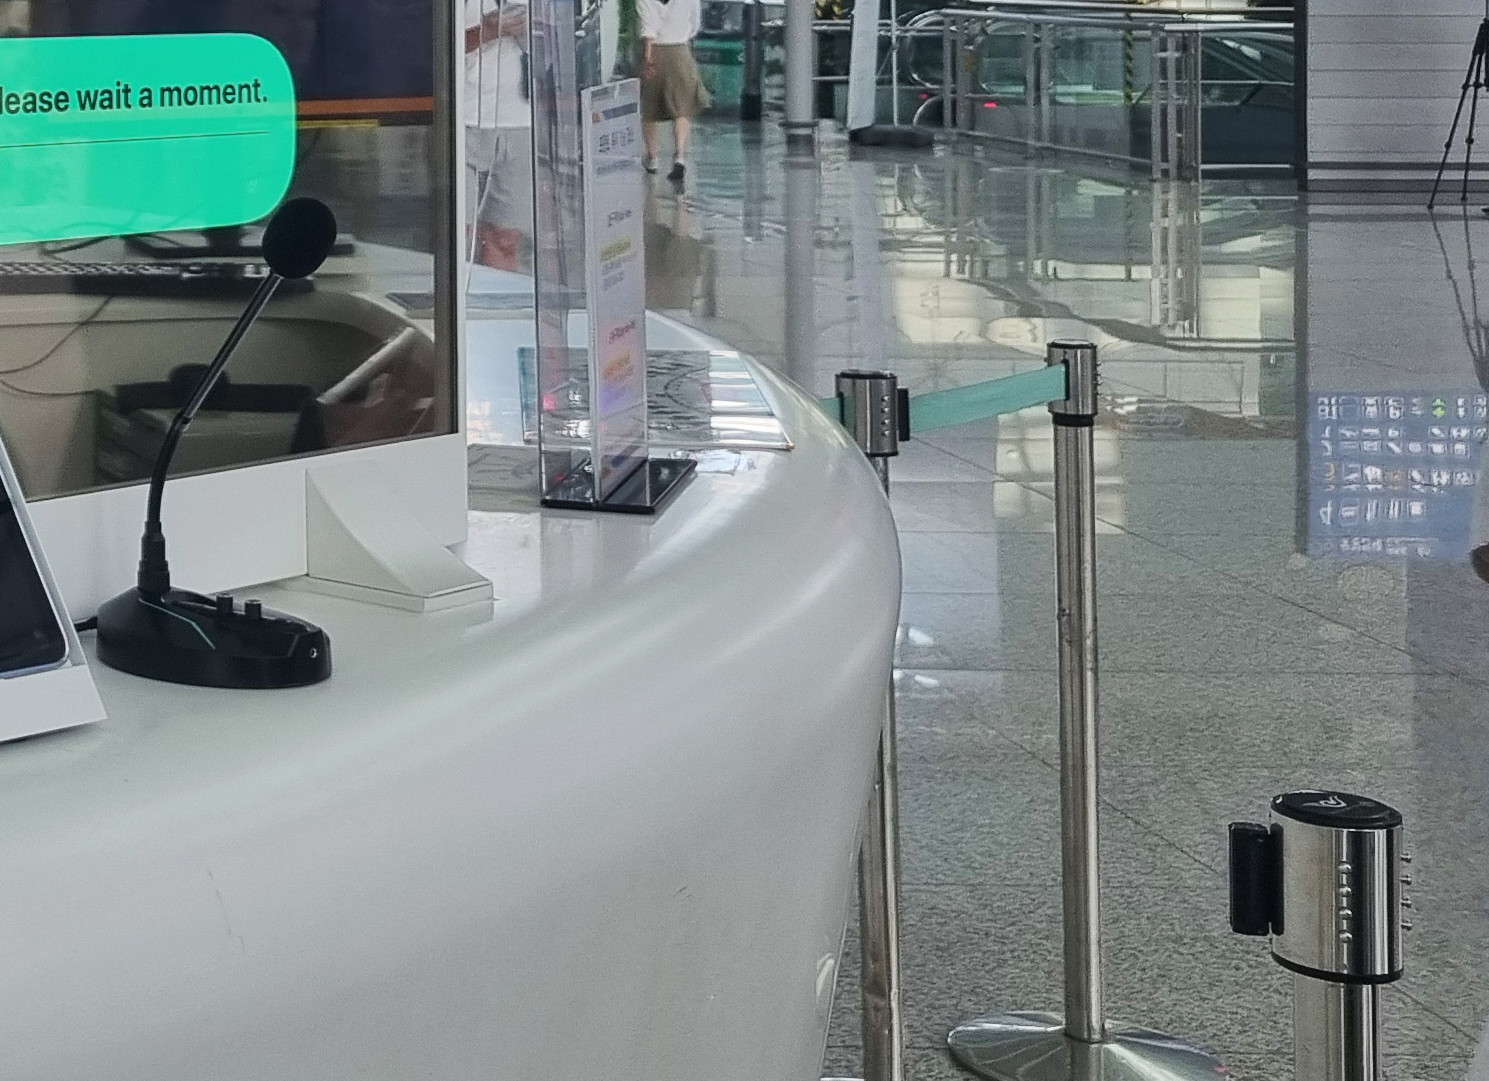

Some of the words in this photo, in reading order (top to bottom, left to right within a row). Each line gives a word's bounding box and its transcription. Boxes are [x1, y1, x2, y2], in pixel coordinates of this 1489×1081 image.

[76, 80, 131, 111] wait
[138, 88, 153, 109] a
[158, 78, 268, 107] moment.
